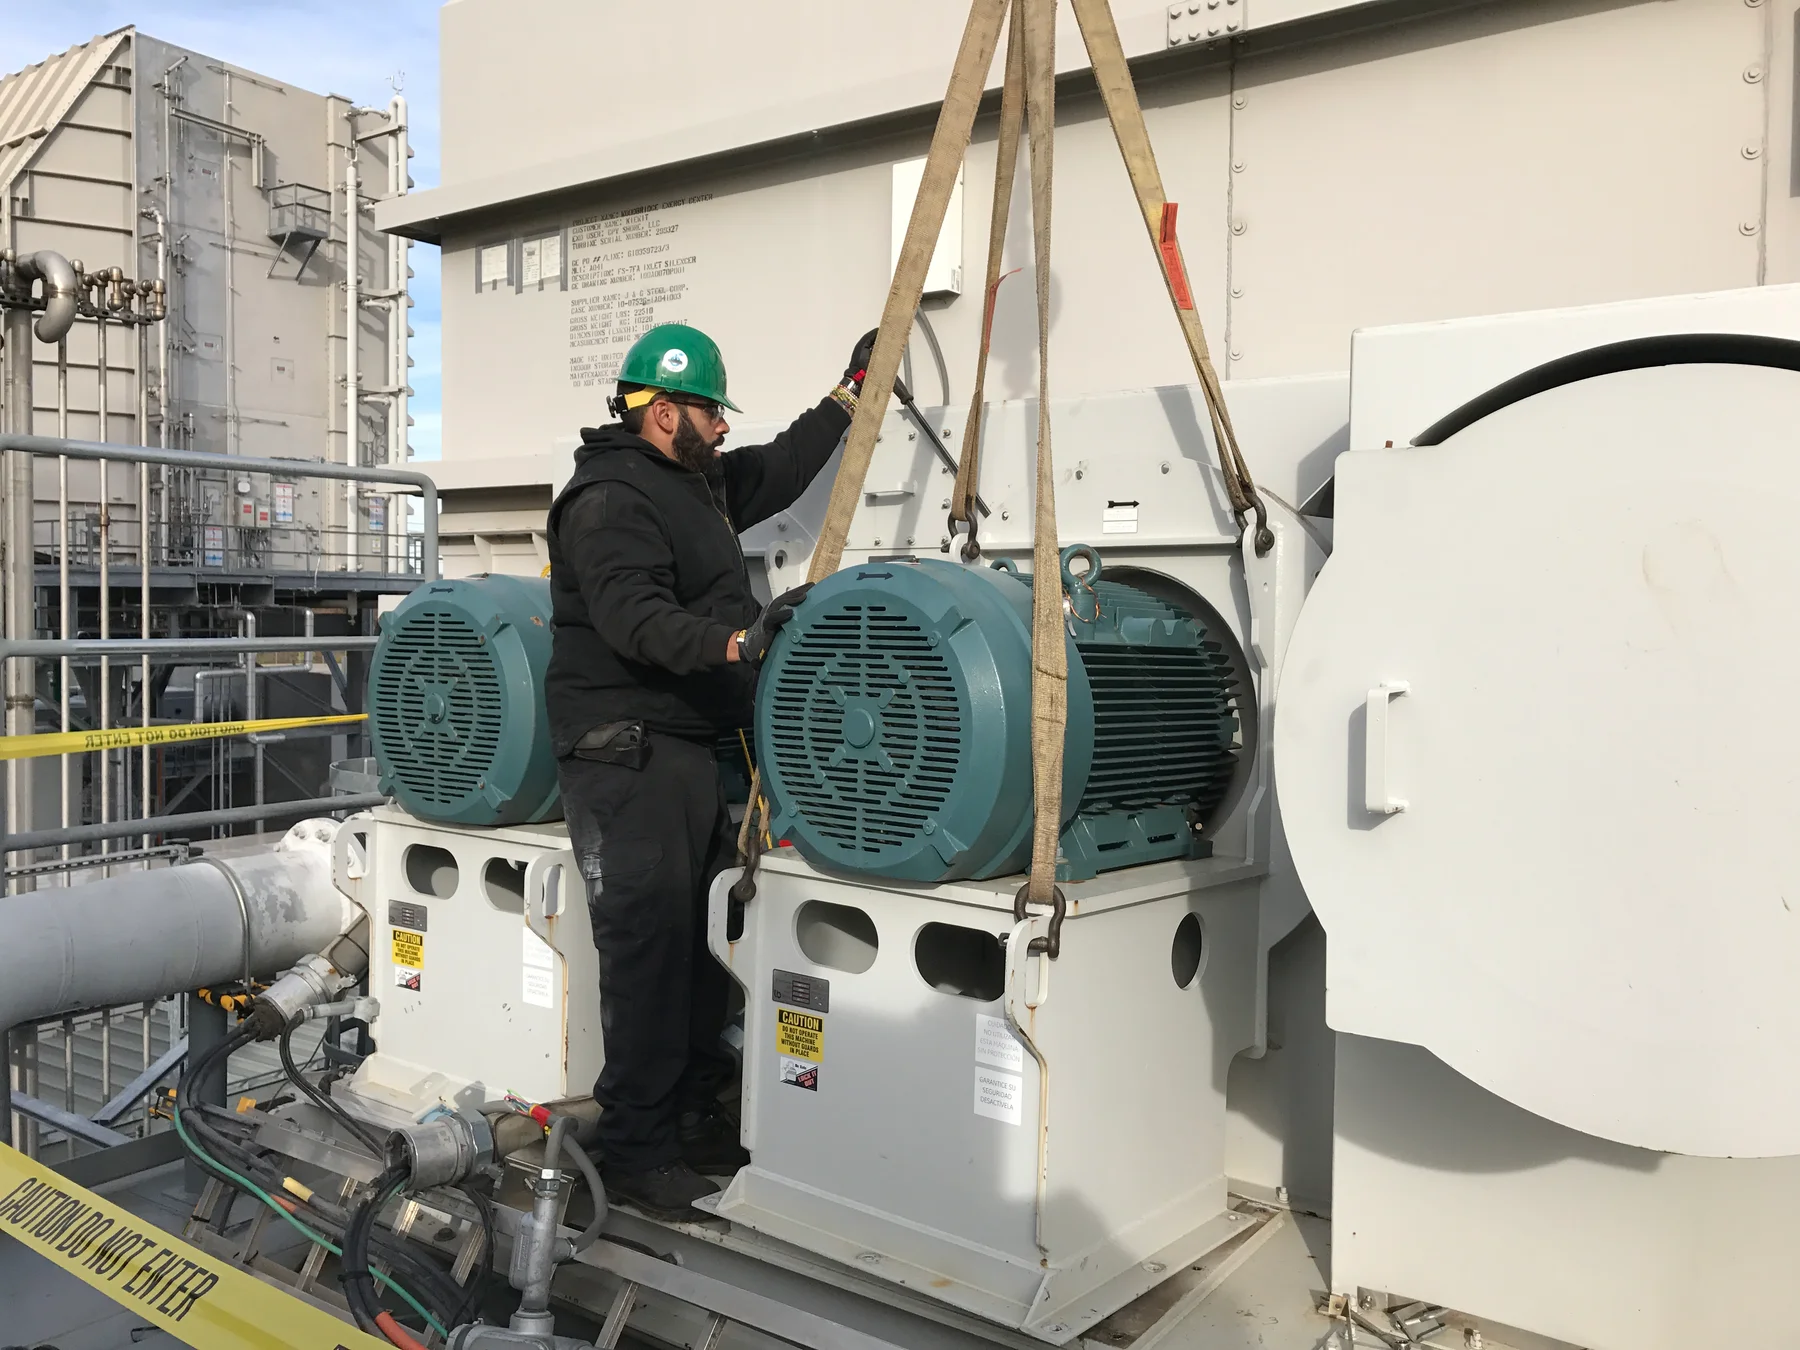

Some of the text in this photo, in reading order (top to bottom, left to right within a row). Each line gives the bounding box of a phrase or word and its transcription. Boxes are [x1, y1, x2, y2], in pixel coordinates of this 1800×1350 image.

[396, 932, 420, 944] CAUTION
[782, 1012, 819, 1030] CAUTION
[784, 1032, 815, 1045] THIS MACHINE
[789, 1026, 798, 1034] NOT
[799, 1029, 818, 1040] OPERATE
[983, 1028, 992, 1037] NO
[781, 1038, 819, 1053] WITHOUT GUARDS
[796, 1048, 809, 1057] PLACE
[979, 1076, 1016, 1092] GARANTICE SU
[982, 1087, 1012, 1100] SEGURIDAD
[0, 1178, 220, 1322] CAUTION DO NOT ENTER
